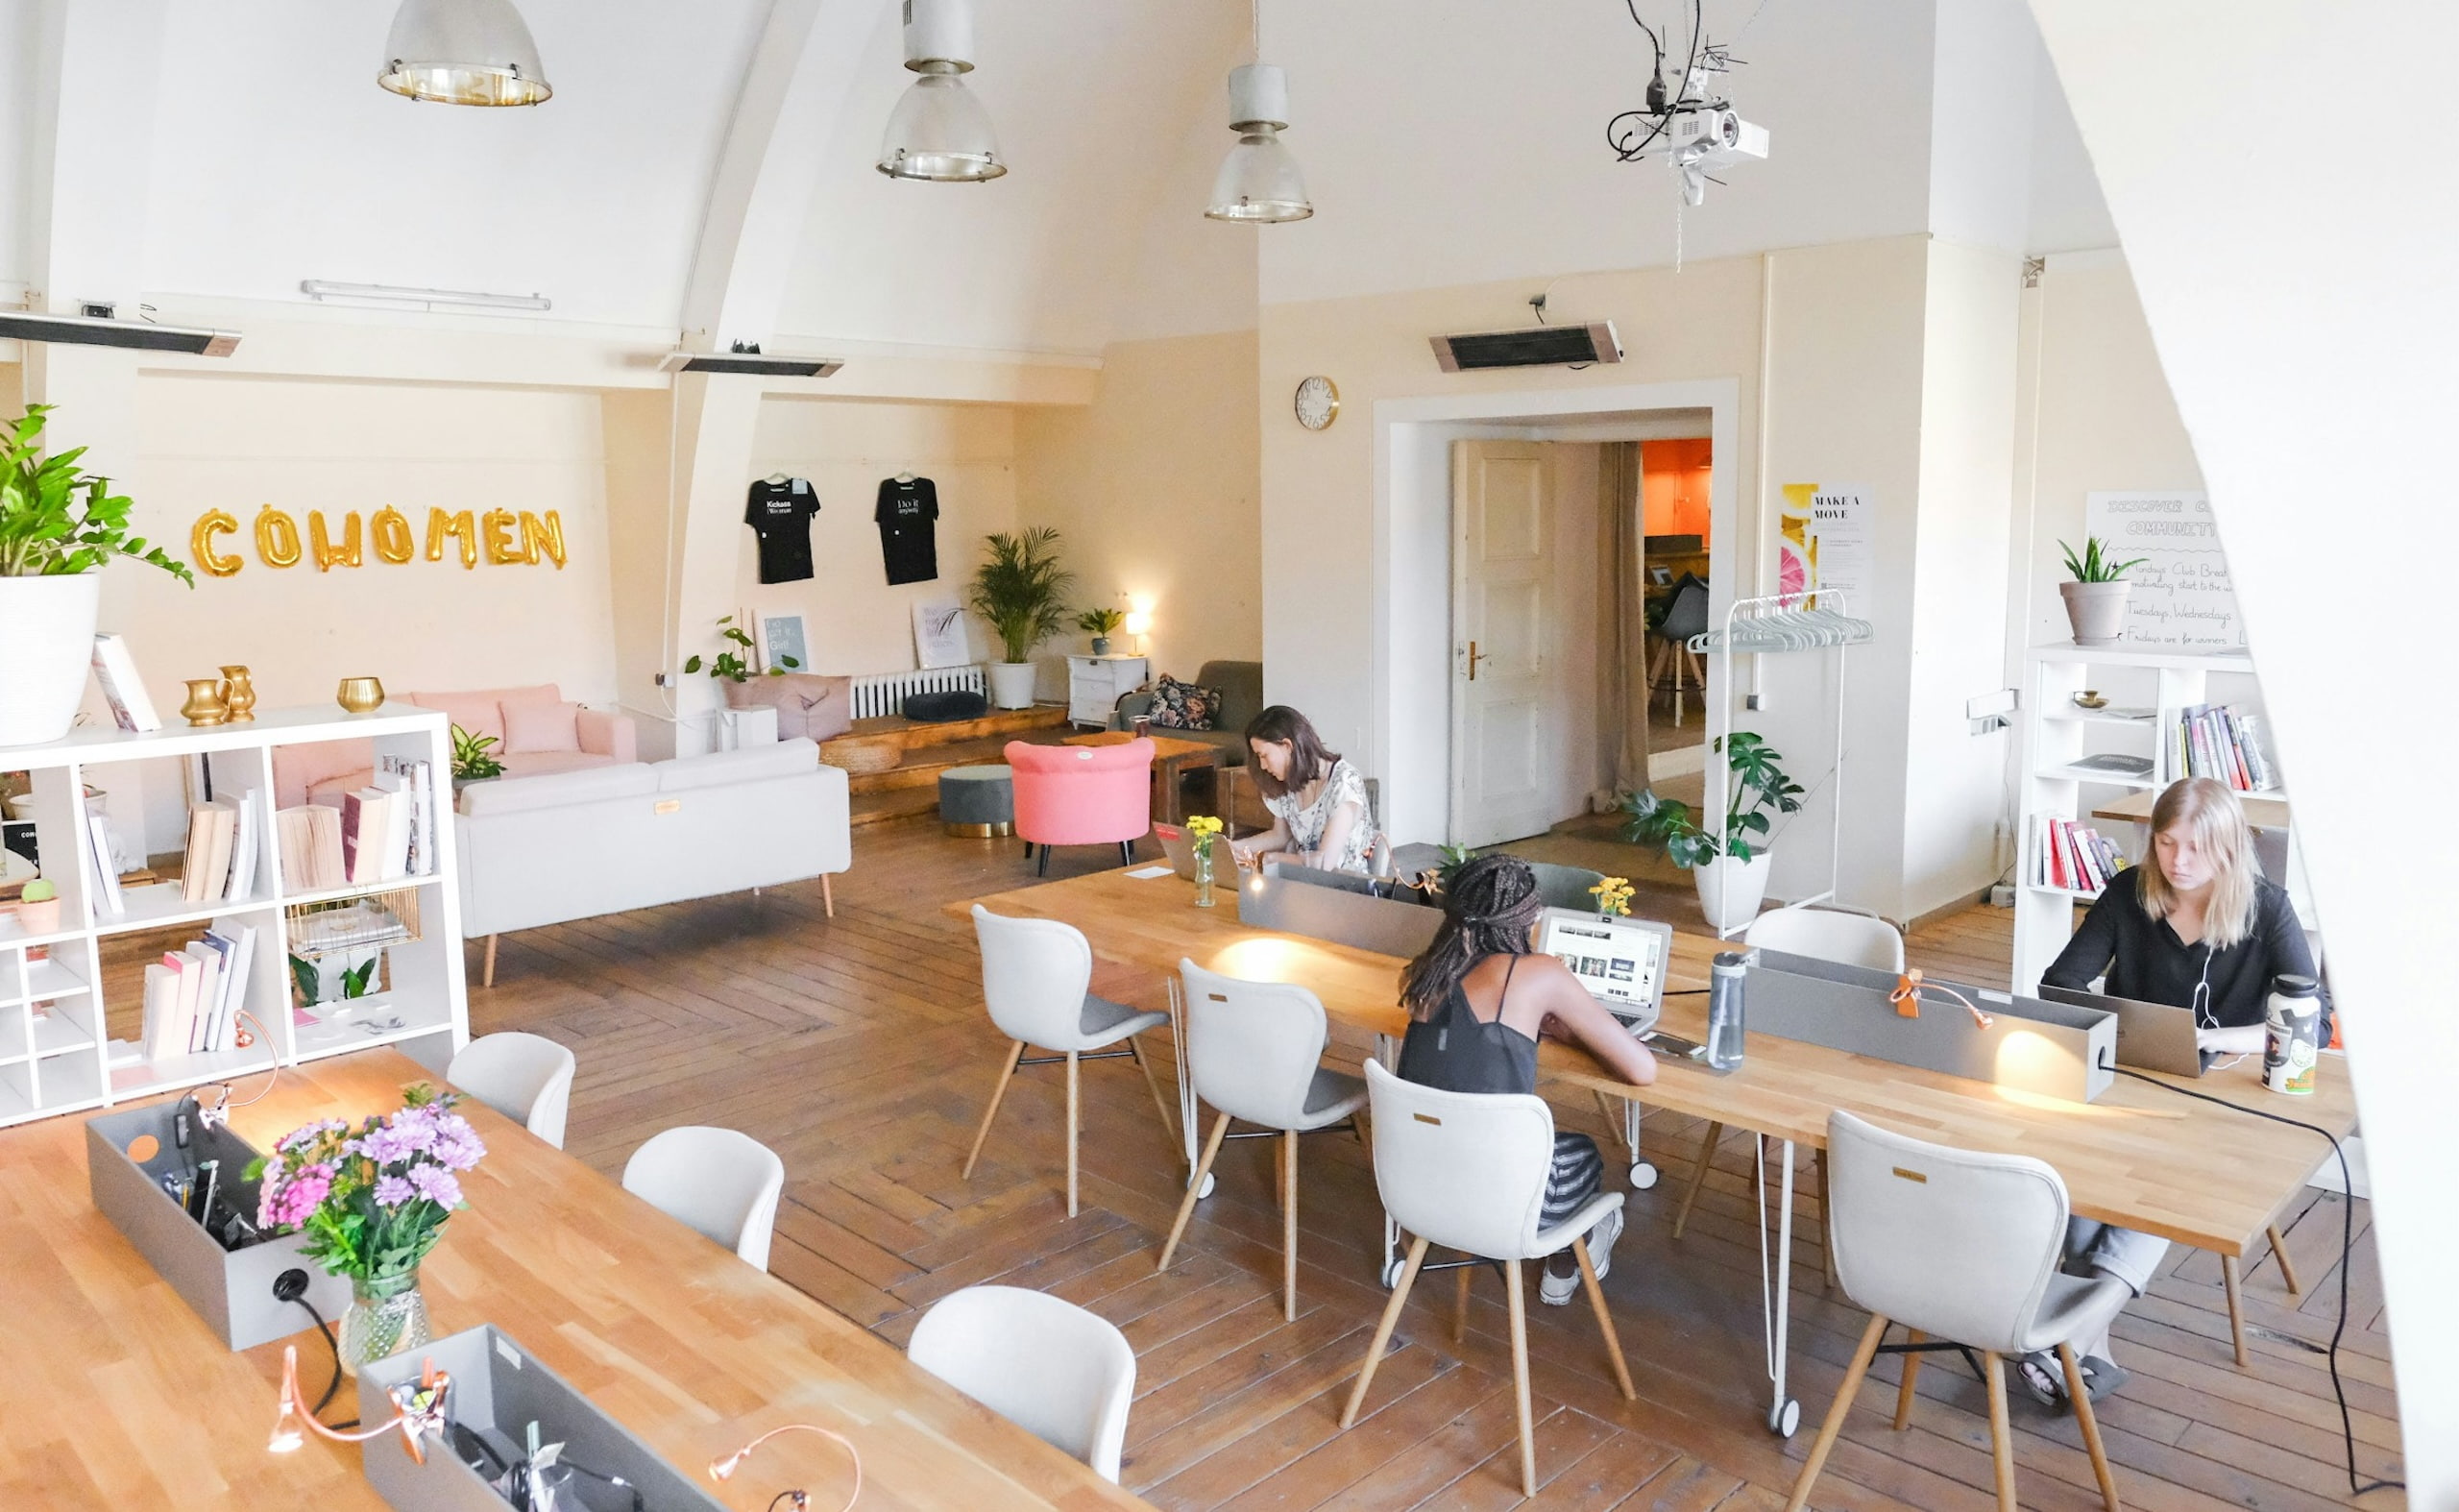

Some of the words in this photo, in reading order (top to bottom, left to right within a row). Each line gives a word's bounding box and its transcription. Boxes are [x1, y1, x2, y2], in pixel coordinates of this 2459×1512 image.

[1815, 496, 1849, 506] MAKE
[1853, 496, 1860, 506] A
[2107, 500, 2182, 513] DISCOVER
[1815, 509, 1849, 520] MOVE
[191, 502, 569, 578] COWOMEN
[2172, 561, 2196, 576] Club
[2179, 579, 2198, 592] start
[2209, 582, 2222, 592] the
[2173, 602, 2231, 630] Wednesdays
[2127, 625, 2162, 644] Fridays
[2164, 636, 2178, 645] are
